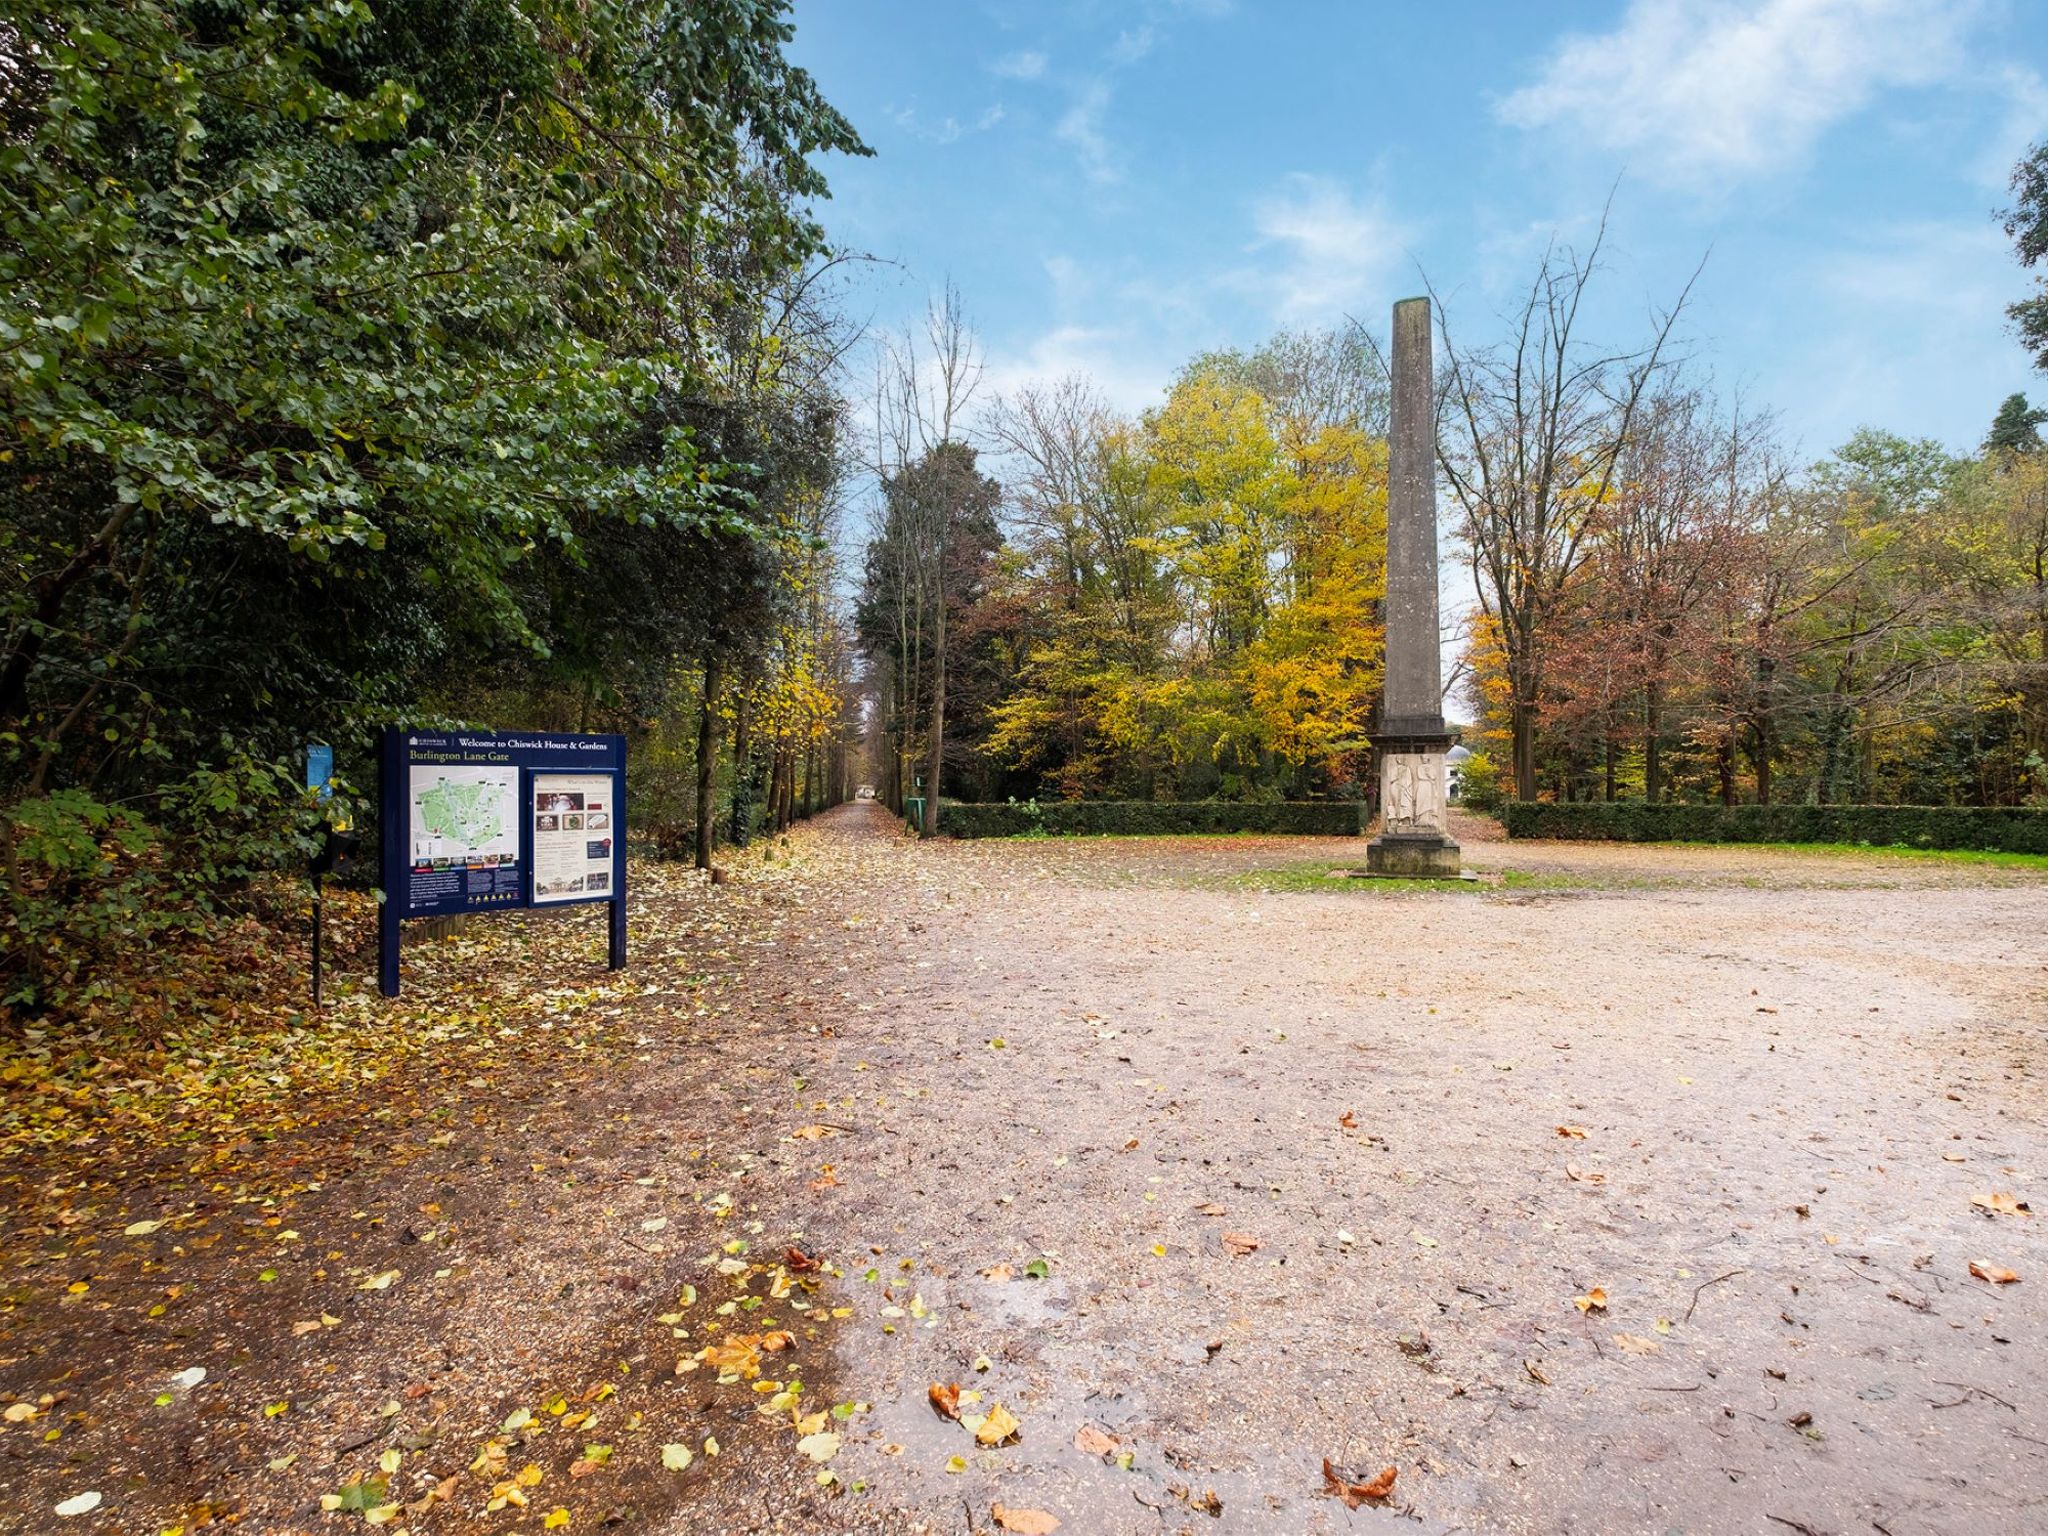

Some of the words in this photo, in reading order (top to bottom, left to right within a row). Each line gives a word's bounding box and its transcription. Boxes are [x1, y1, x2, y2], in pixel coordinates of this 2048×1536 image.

[459, 738, 496, 747] Welcome
[498, 740, 506, 748] to
[507, 739, 543, 749] Chiswick
[544, 740, 568, 750] House
[569, 741, 577, 750] &
[578, 741, 608, 750] Gardens
[410, 749, 461, 763] Burlington
[464, 751, 486, 761] Lane
[488, 751, 509, 761] Gate
